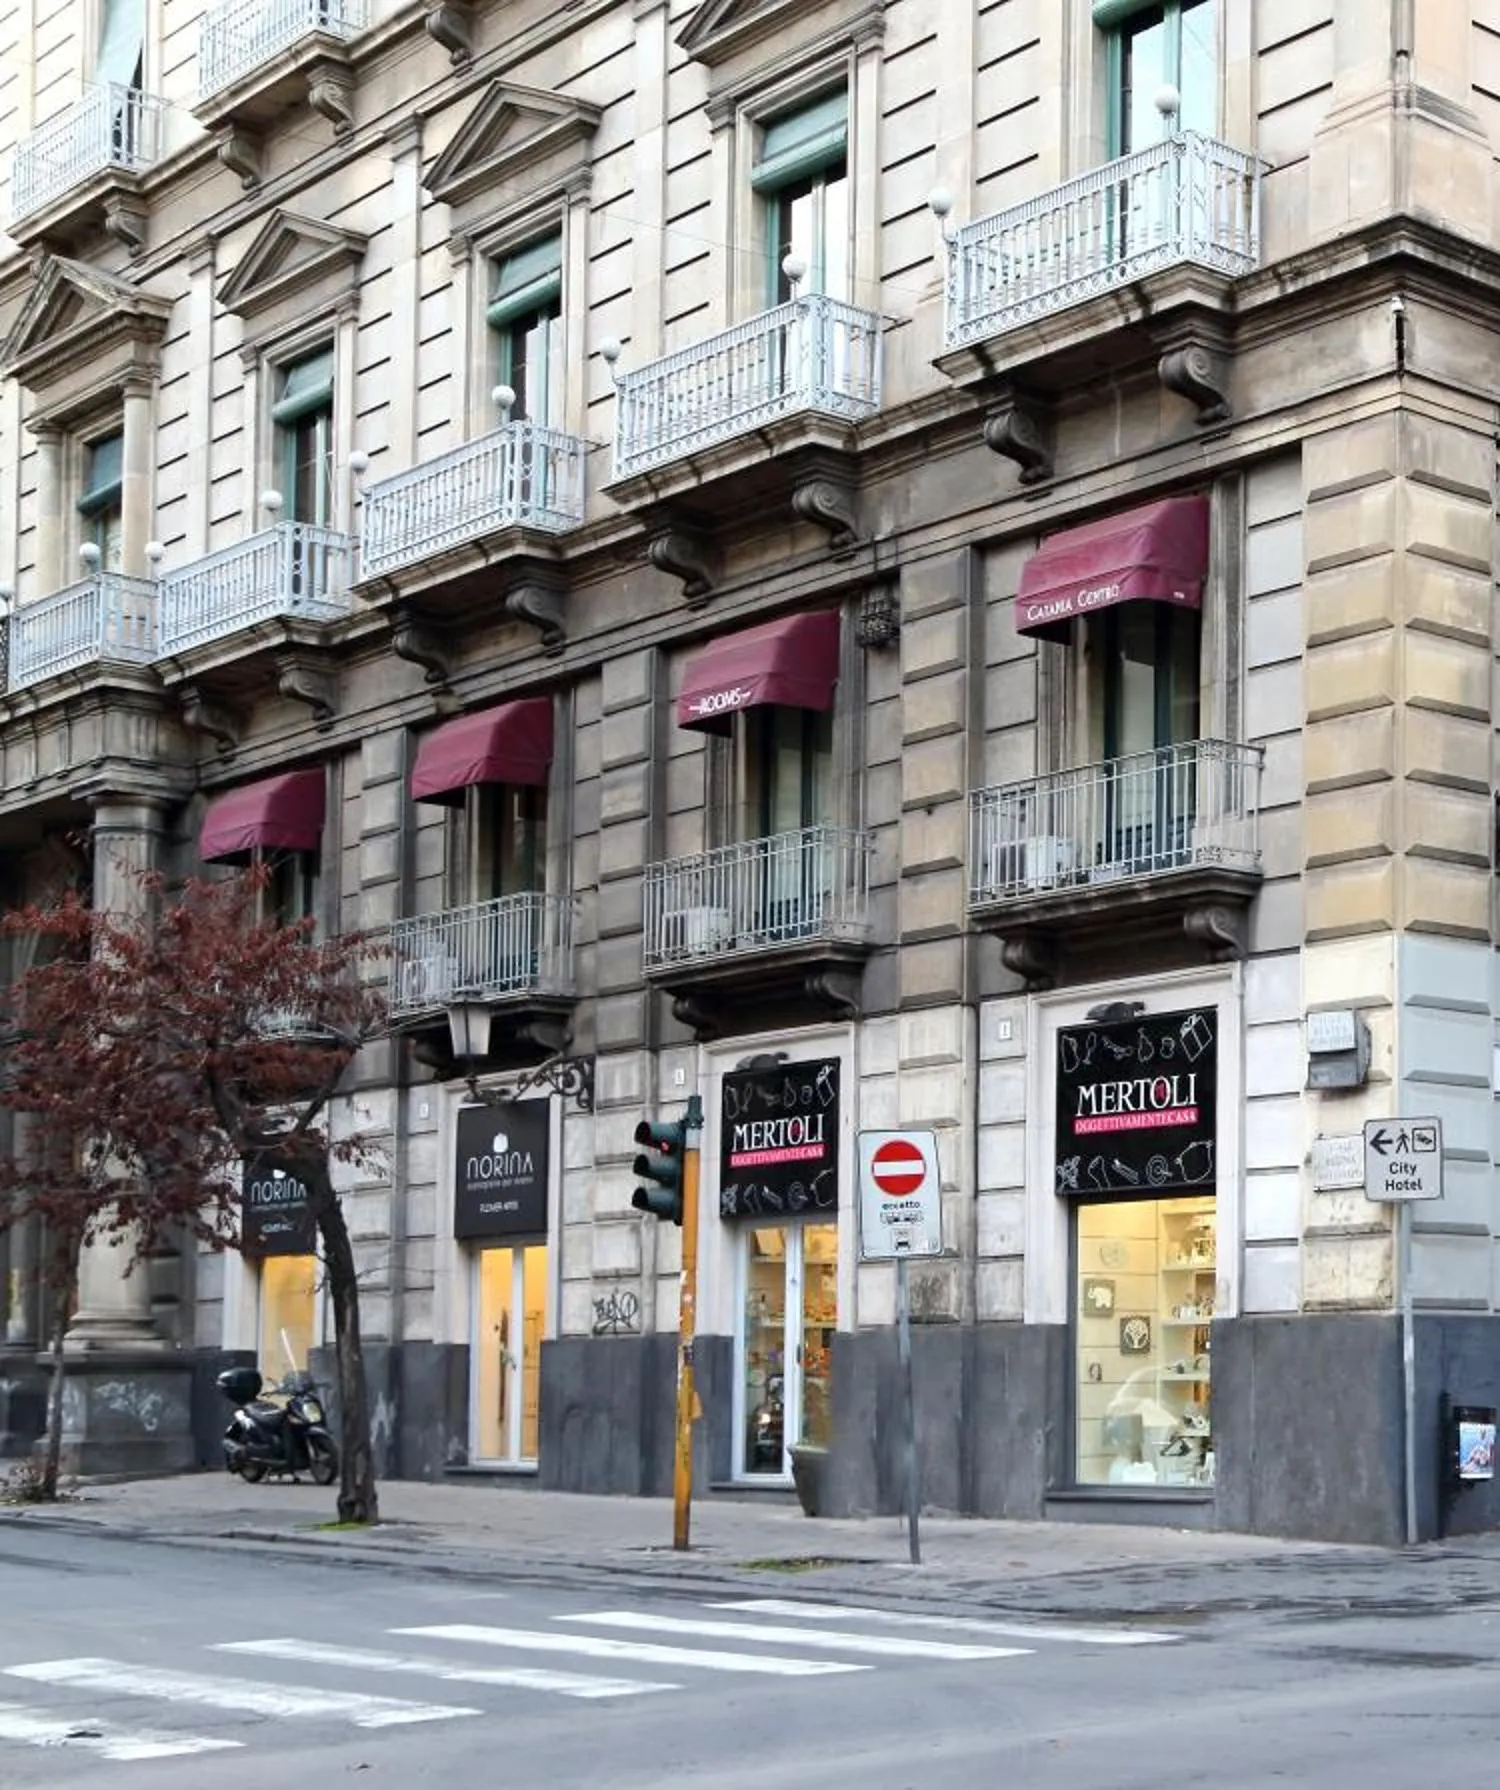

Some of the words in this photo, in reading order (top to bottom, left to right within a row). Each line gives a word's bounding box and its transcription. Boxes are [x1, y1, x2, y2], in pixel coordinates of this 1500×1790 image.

[1075, 1073, 1198, 1117] MERTOLI
[731, 1113, 825, 1152] MERTOLI
[466, 1151, 534, 1179] NORINA
[1388, 1161, 1418, 1176] City
[1384, 1178, 1423, 1192] Hotel
